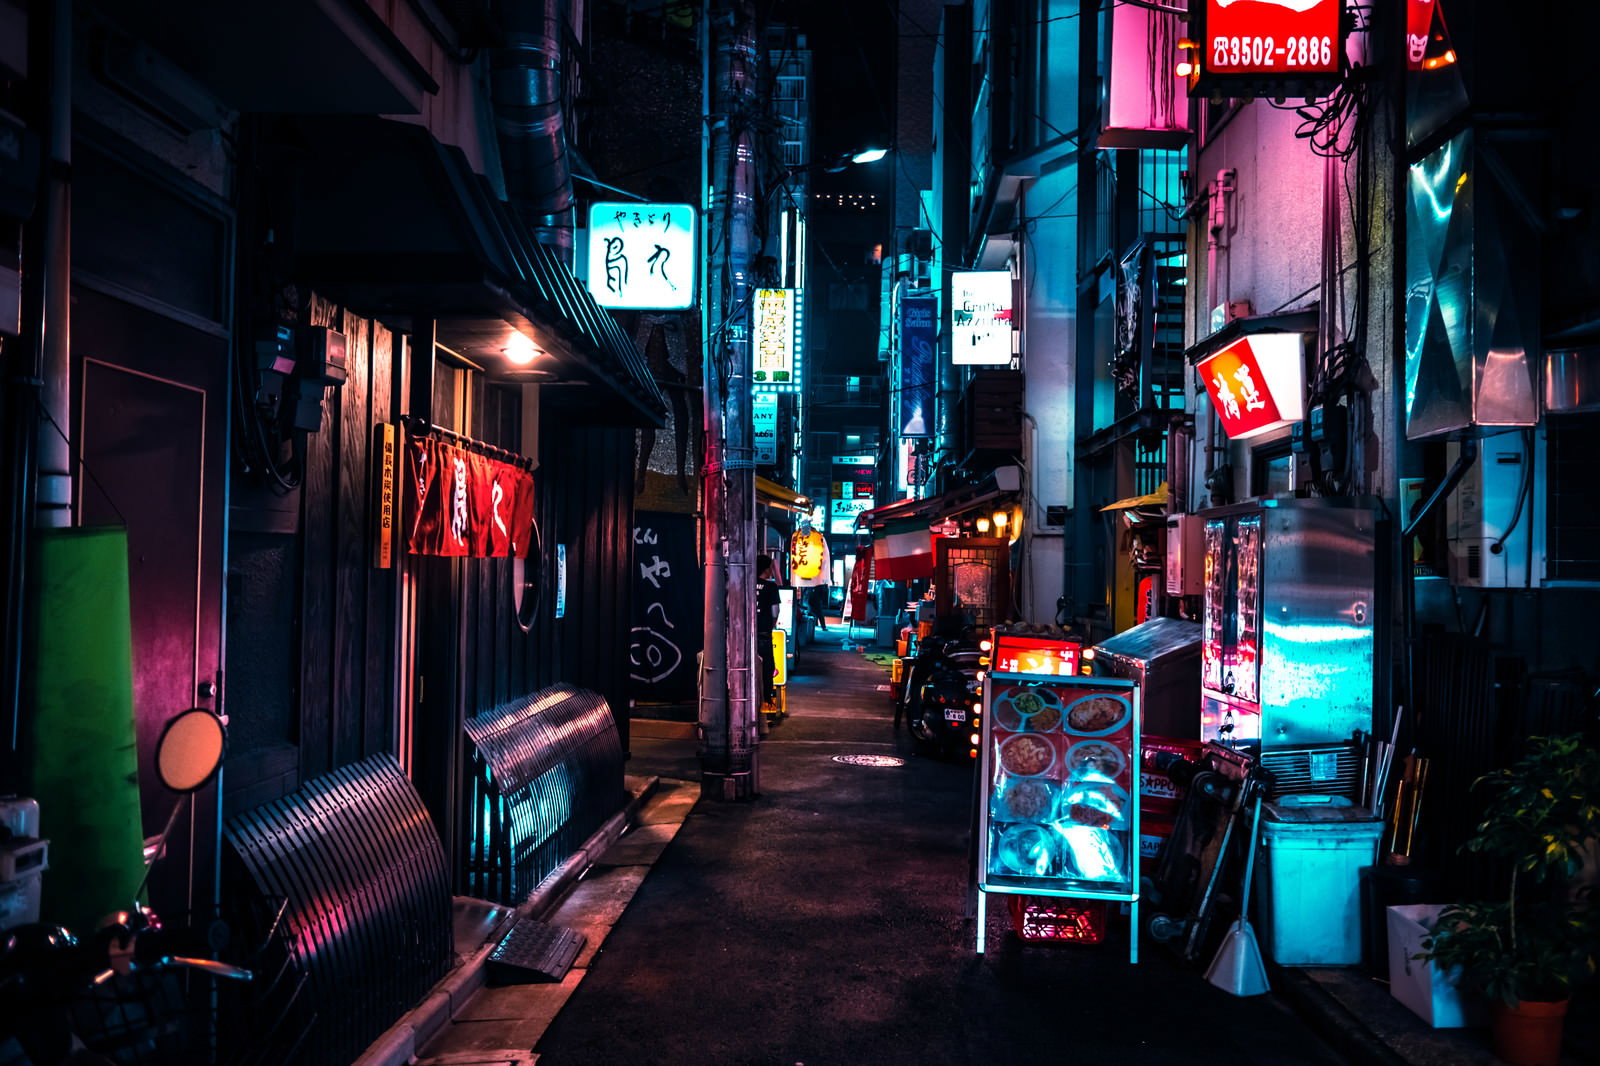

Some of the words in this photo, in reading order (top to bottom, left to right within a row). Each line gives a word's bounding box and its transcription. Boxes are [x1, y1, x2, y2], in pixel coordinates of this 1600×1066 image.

[1230, 36, 1331, 66] 3502-2886
[614, 211, 671, 233] やきとり
